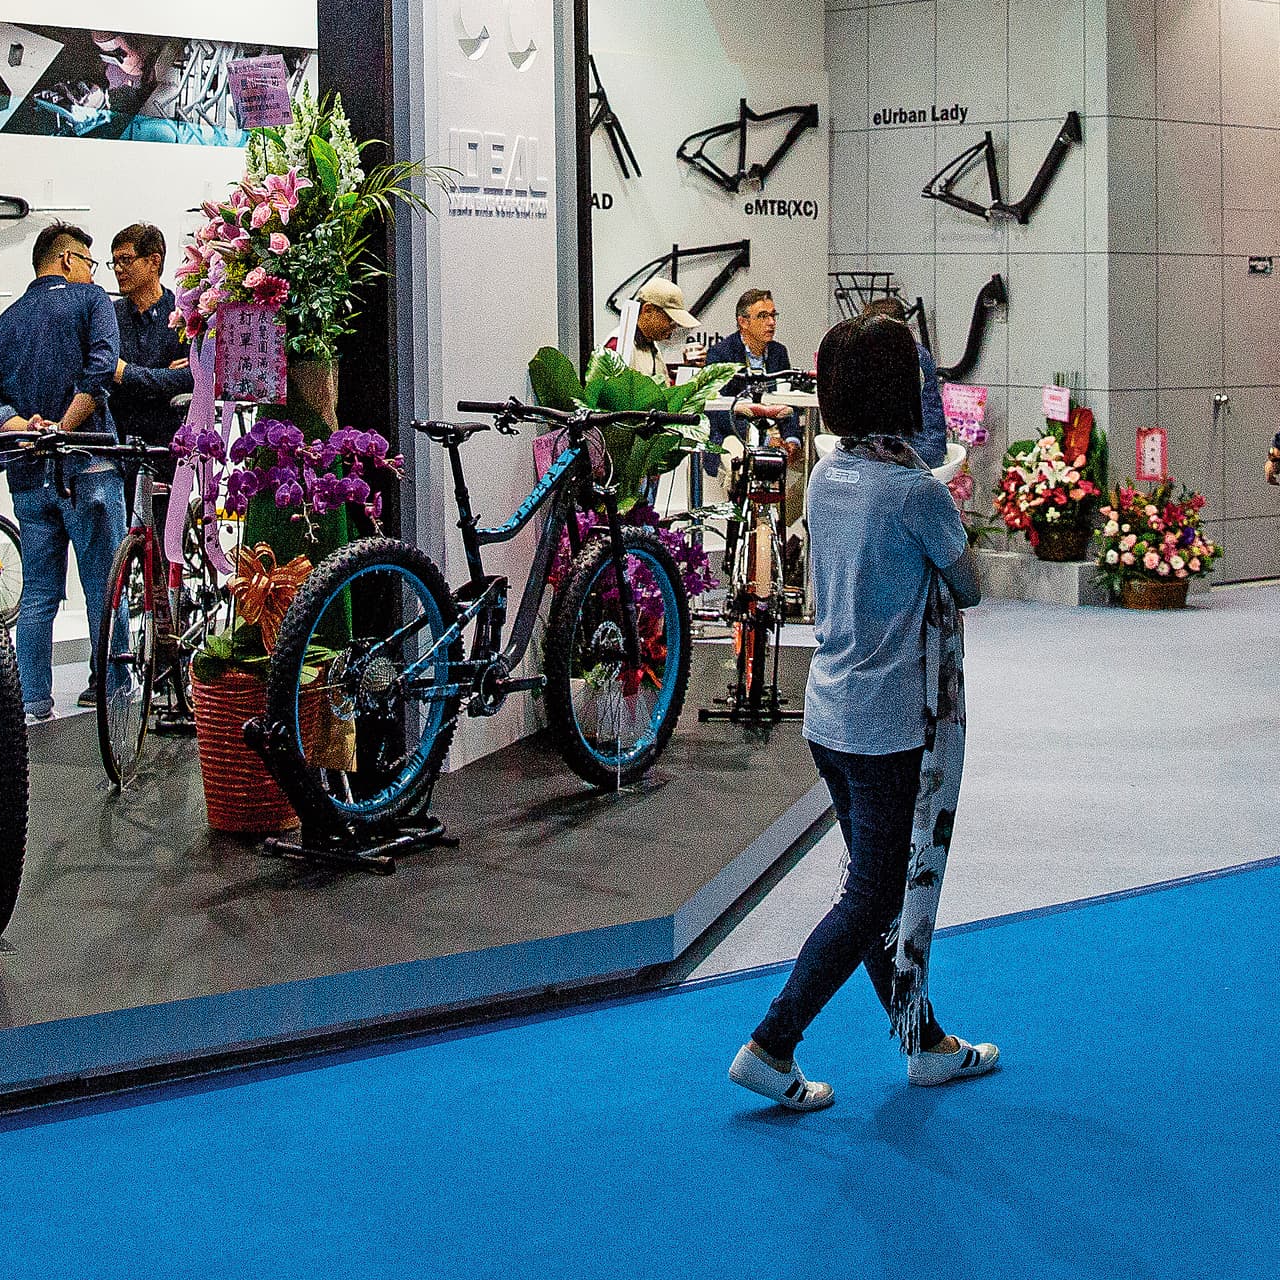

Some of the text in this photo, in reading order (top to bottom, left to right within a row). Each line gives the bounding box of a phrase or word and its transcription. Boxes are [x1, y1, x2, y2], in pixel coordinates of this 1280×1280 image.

[873, 104, 968, 125] eUrban Lady
[448, 127, 548, 198] IDEAL
[744, 199, 818, 220] eMTB(XC)
